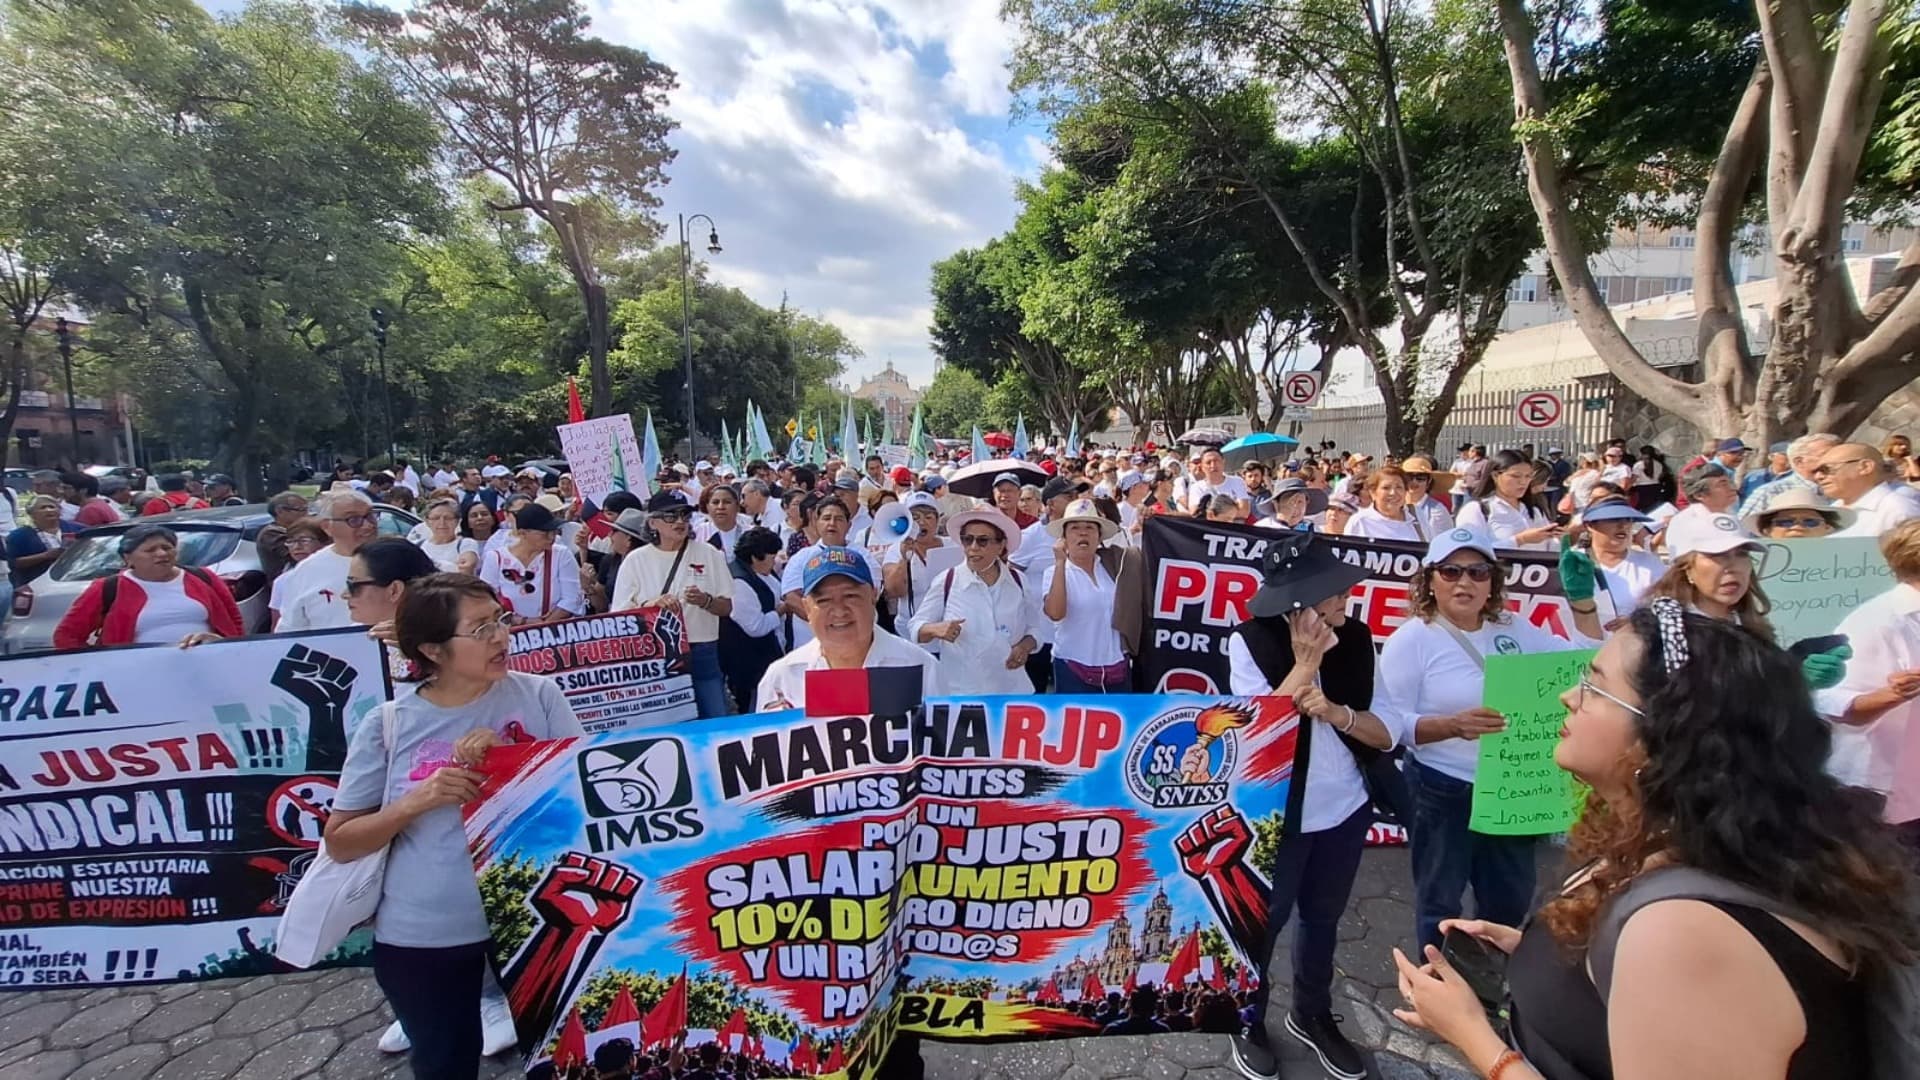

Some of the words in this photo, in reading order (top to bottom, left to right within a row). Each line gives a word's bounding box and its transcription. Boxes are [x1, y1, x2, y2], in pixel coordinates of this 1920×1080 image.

[508, 615, 639, 655] RABAJADORES
[557, 644, 571, 668] Y
[574, 633, 656, 666] FUERTES
[1155, 629, 1211, 654] POR
[567, 662, 661, 690] SOLICITADAS
[606, 689, 625, 701] 10%
[1536, 660, 1590, 698] Exigim
[32, 732, 239, 787] JUSTA
[718, 703, 990, 801] MARCHA
[1002, 704, 1122, 769] RJP
[1150, 744, 1177, 774] SS
[813, 776, 900, 816] IMSS
[921, 768, 1026, 796] SNTSS
[1156, 783, 1226, 806] SNTSS
[584, 808, 704, 854] IMSS
[863, 806, 919, 848] POR
[926, 803, 977, 828] UN
[72, 858, 210, 878] ESTATUTARIA
[707, 823, 940, 909] SALARIO
[947, 818, 1122, 865] JUSTO
[71, 877, 172, 897] NUESTRA
[711, 899, 822, 951] 10%
[829, 893, 891, 941] DE
[898, 858, 1119, 901] AUMENTO
[31, 902, 61, 919] DE
[69, 898, 186, 919] EXPRESIÓN
[742, 948, 769, 981] Y
[777, 944, 828, 980] UN
[965, 897, 1090, 931] DIGNO
[32, 966, 90, 984] SERÁ
[824, 948, 897, 1019] PARA
[900, 929, 1018, 959] TOD@S
